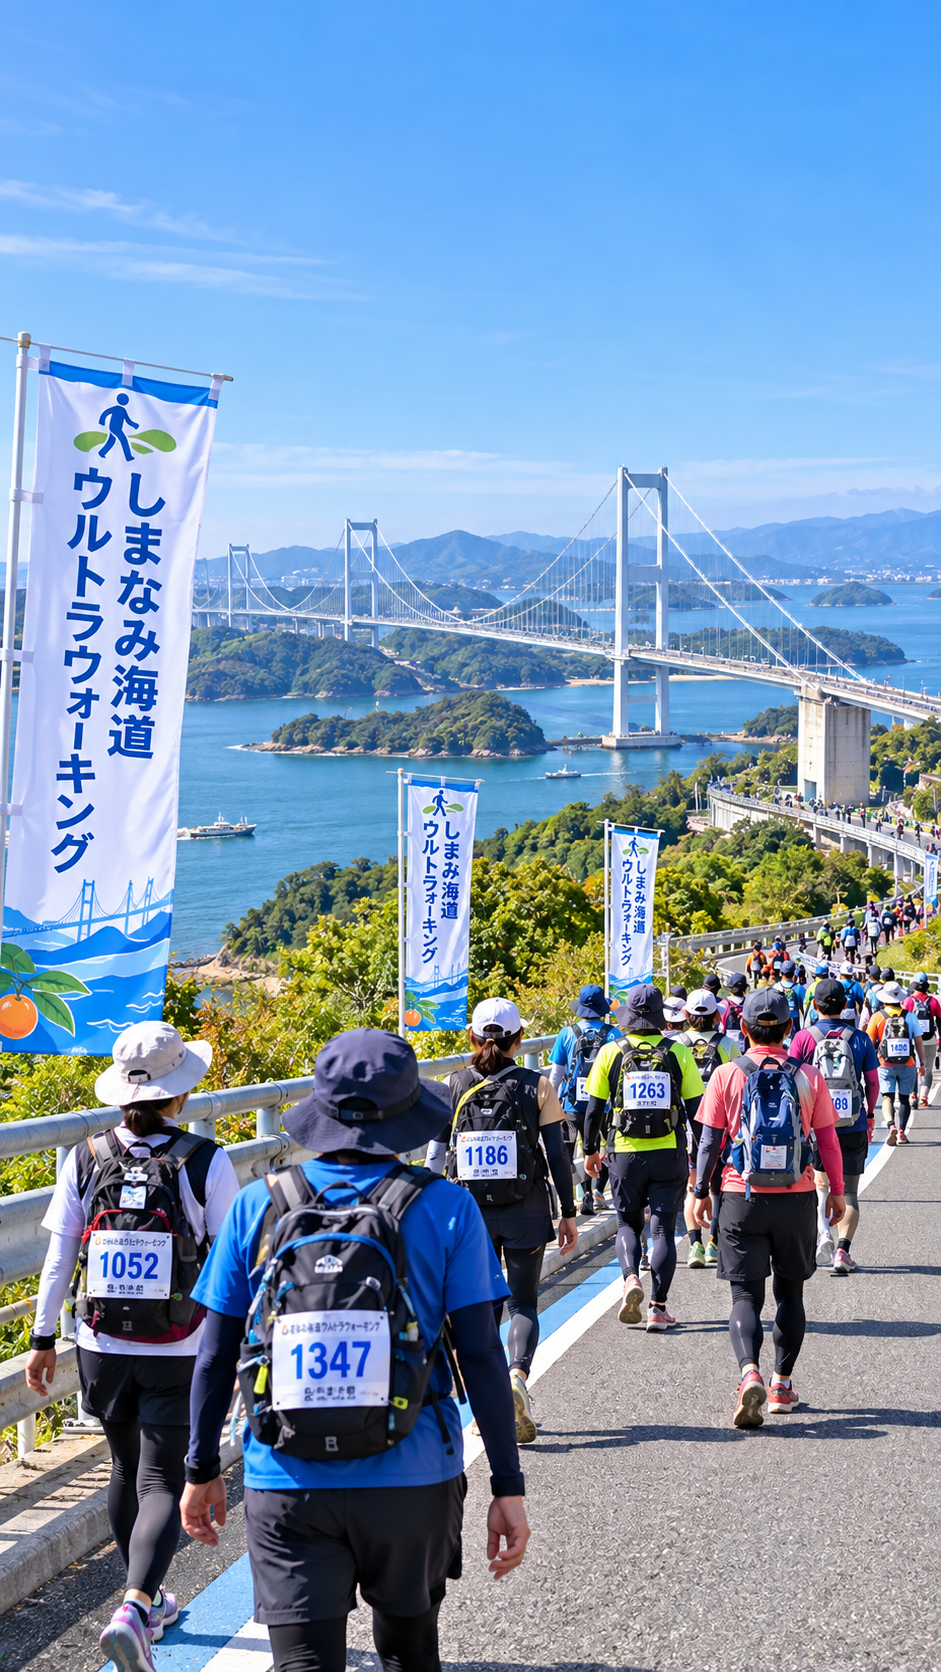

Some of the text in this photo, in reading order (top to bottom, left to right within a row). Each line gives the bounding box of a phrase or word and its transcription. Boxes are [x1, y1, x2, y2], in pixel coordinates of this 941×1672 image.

[107, 473, 165, 759] しまなみ海道
[51, 467, 112, 874] ウルトラウォーキング
[630, 1082, 665, 1098] 1263
[465, 1145, 508, 1166] 1186
[100, 1252, 158, 1279] 1052
[291, 1341, 371, 1379] 1347
